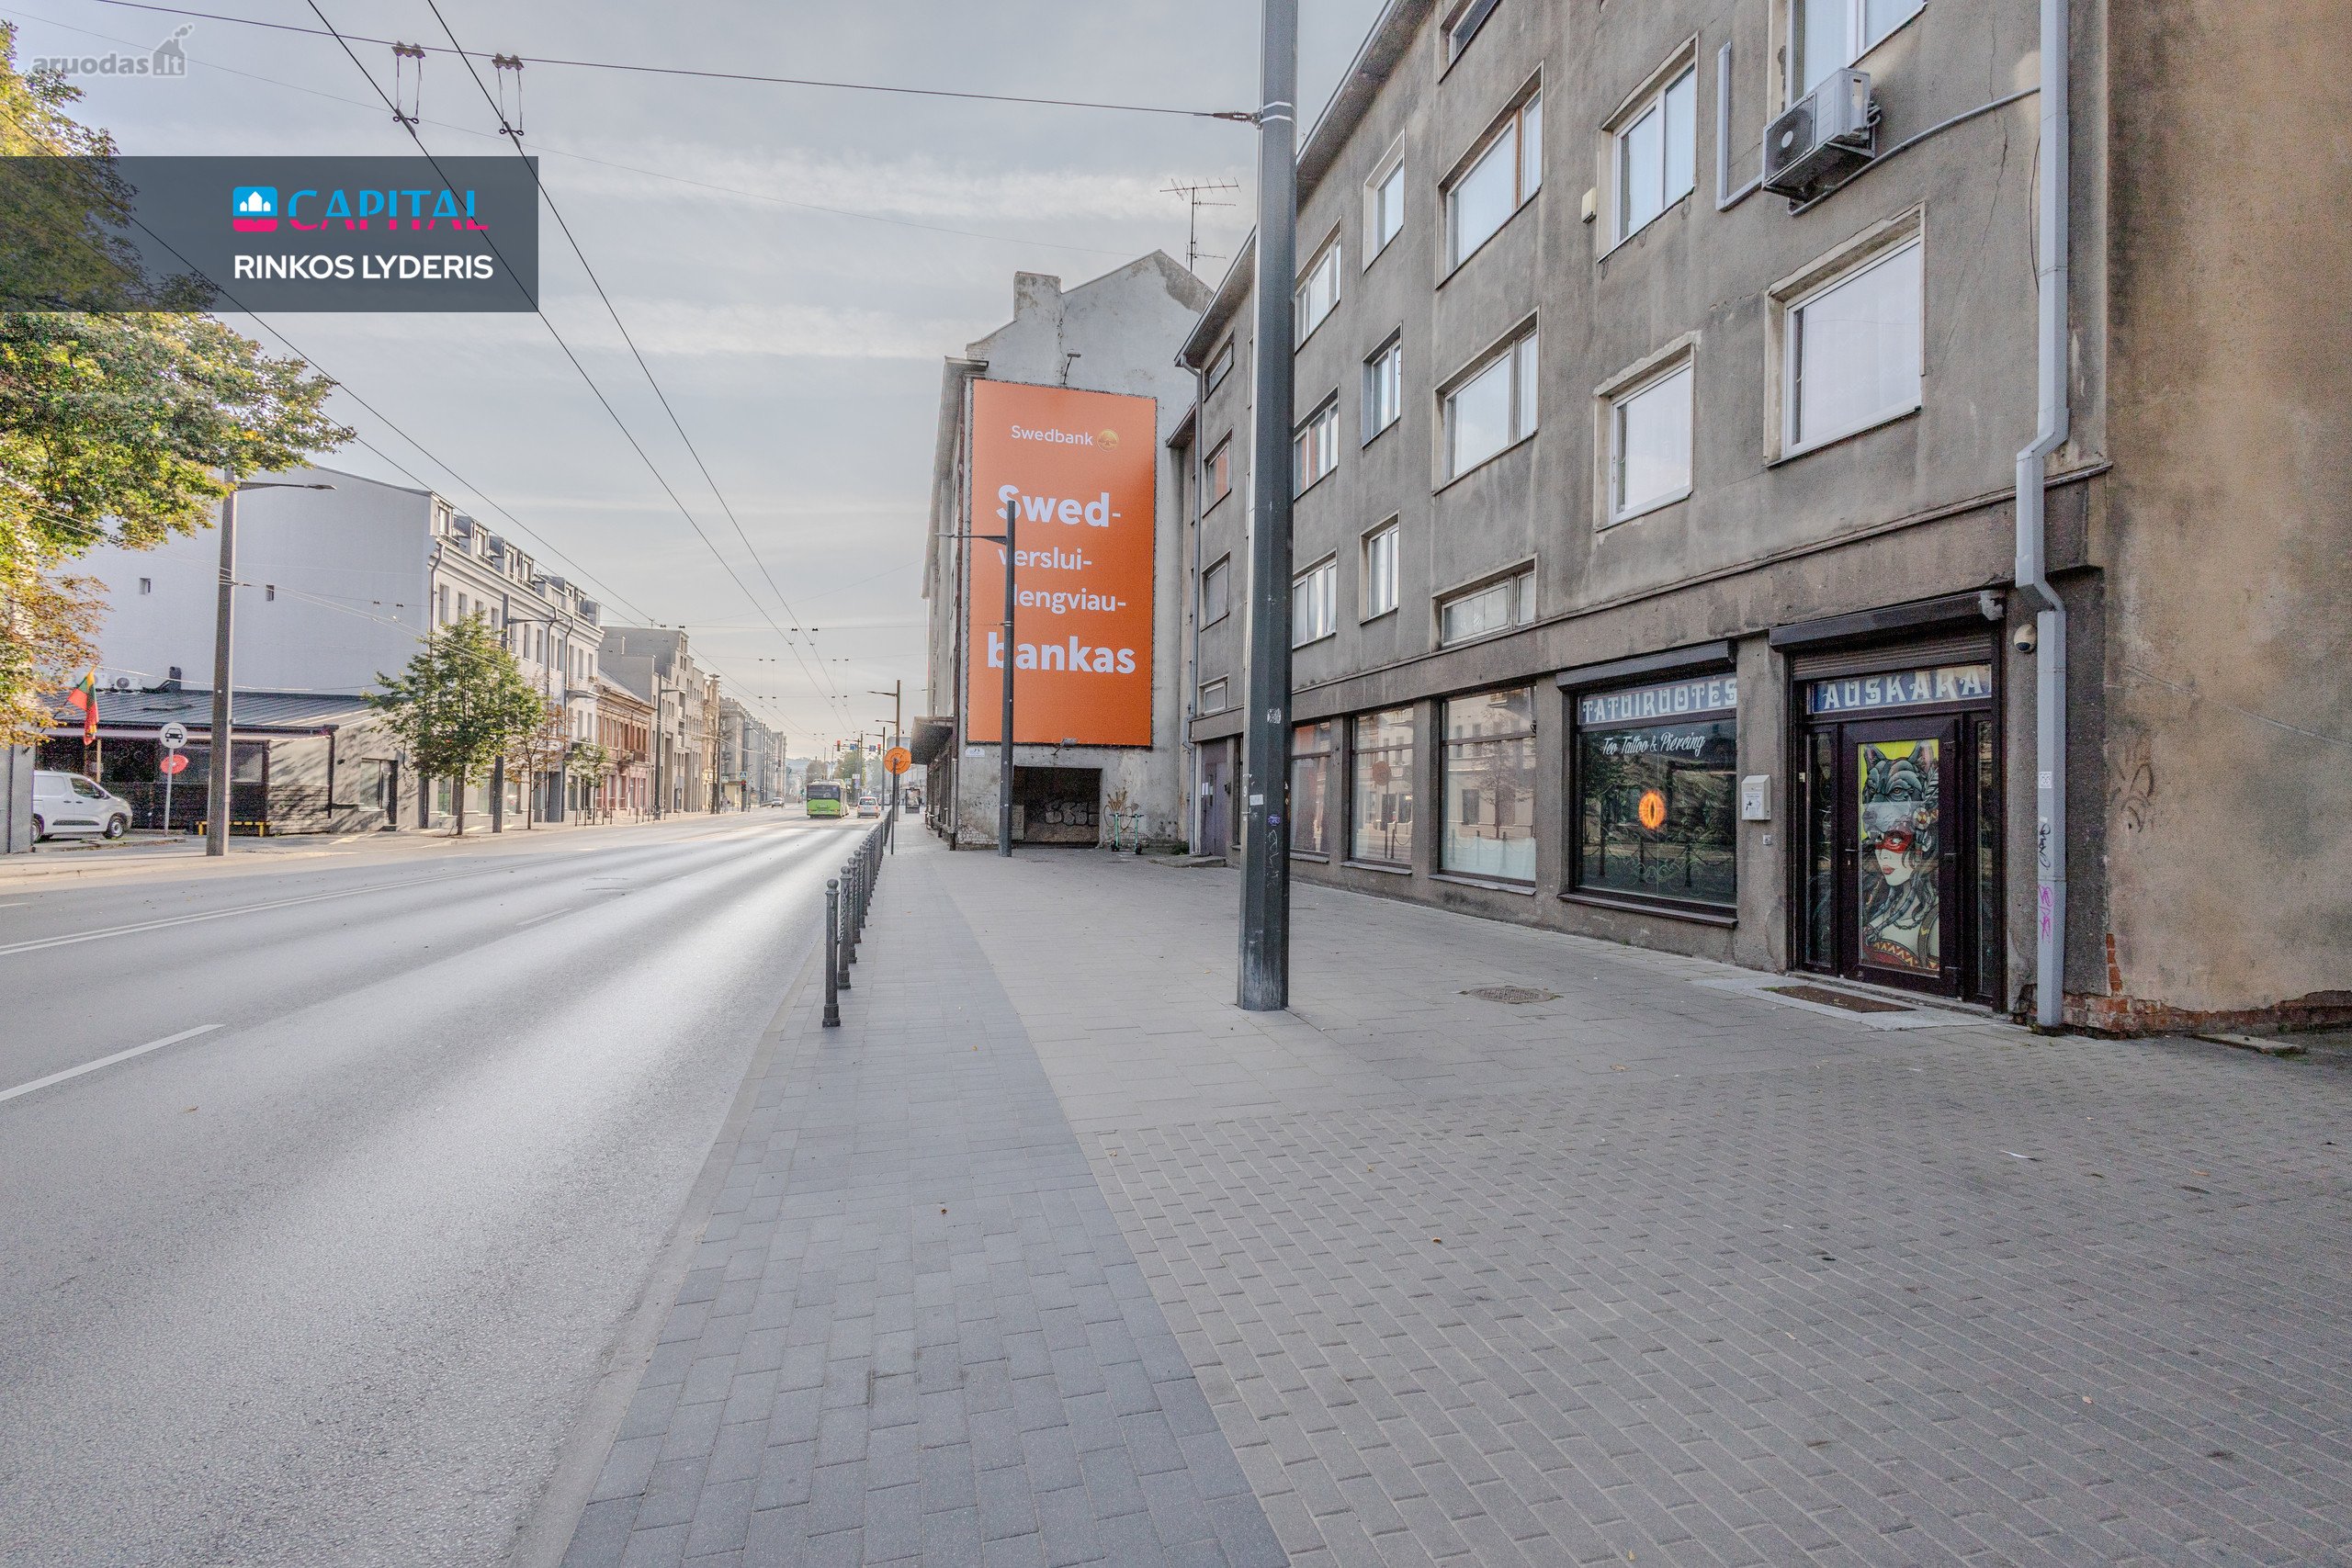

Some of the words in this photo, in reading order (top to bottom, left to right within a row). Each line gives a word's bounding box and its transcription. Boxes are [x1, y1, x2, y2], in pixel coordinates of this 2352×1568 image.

[1011, 424, 1093, 446] Swedbank
[996, 484, 1121, 528] Swed-
[988, 631, 1136, 674] bankas
[1822, 667, 1991, 709] AUSKARA
[1602, 737, 1617, 756] Teo
[1621, 735, 1650, 755] Tattoo
[1652, 735, 1657, 752] &
[1660, 732, 1706, 757] Piercing
